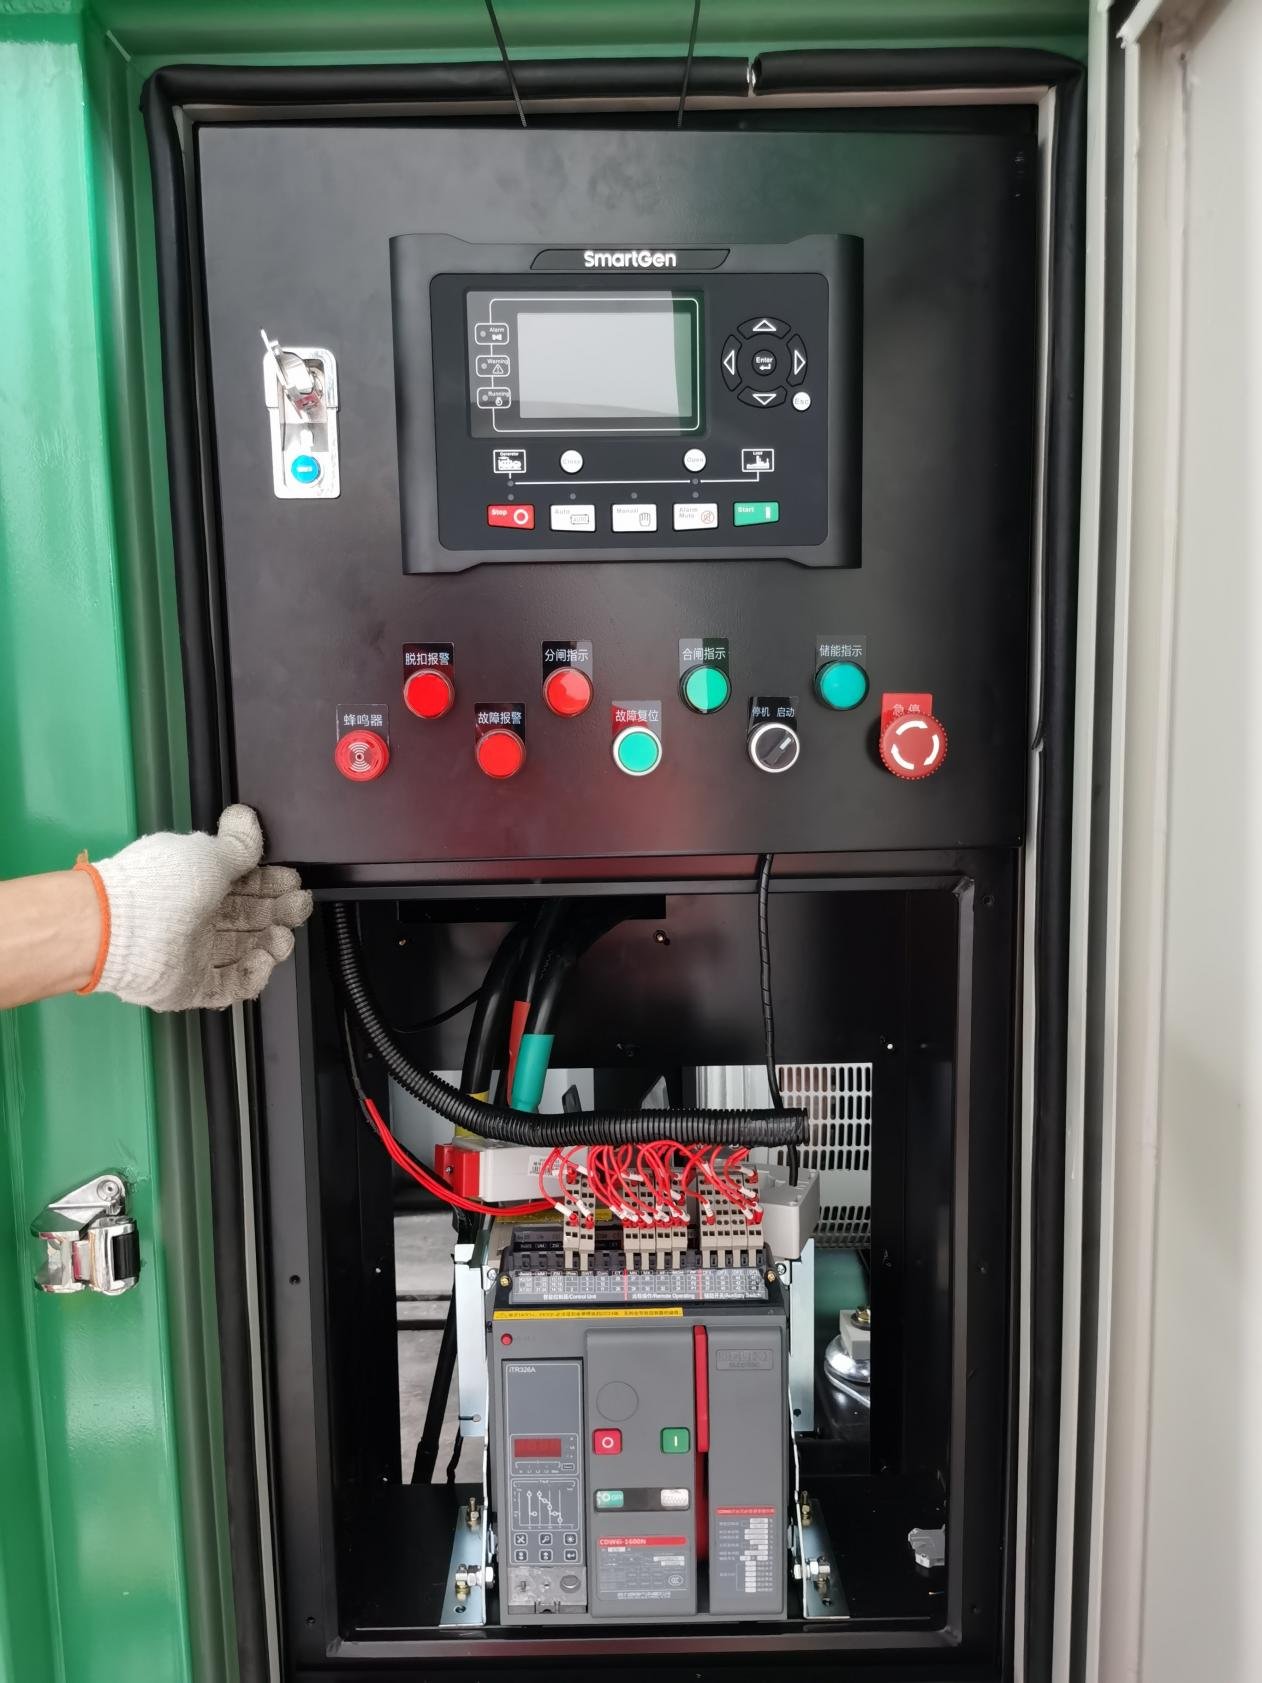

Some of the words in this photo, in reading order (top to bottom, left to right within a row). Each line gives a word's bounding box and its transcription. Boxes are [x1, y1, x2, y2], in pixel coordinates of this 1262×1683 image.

[583, 249, 677, 268] SmartGen
[755, 356, 773, 364] Enter
[794, 397, 810, 405] Esc
[491, 508, 508, 516] Stop
[544, 648, 590, 663] 分闸指示
[682, 647, 726, 661] 合闸指示
[819, 644, 863, 658] 储能指示
[405, 652, 450, 667] 脱扣报警
[477, 711, 523, 726] 故障报警
[615, 709, 660, 723] 故障复位
[752, 706, 770, 717] 停机
[776, 706, 796, 718] 启动
[343, 713, 384, 728] 蜂鸣器
